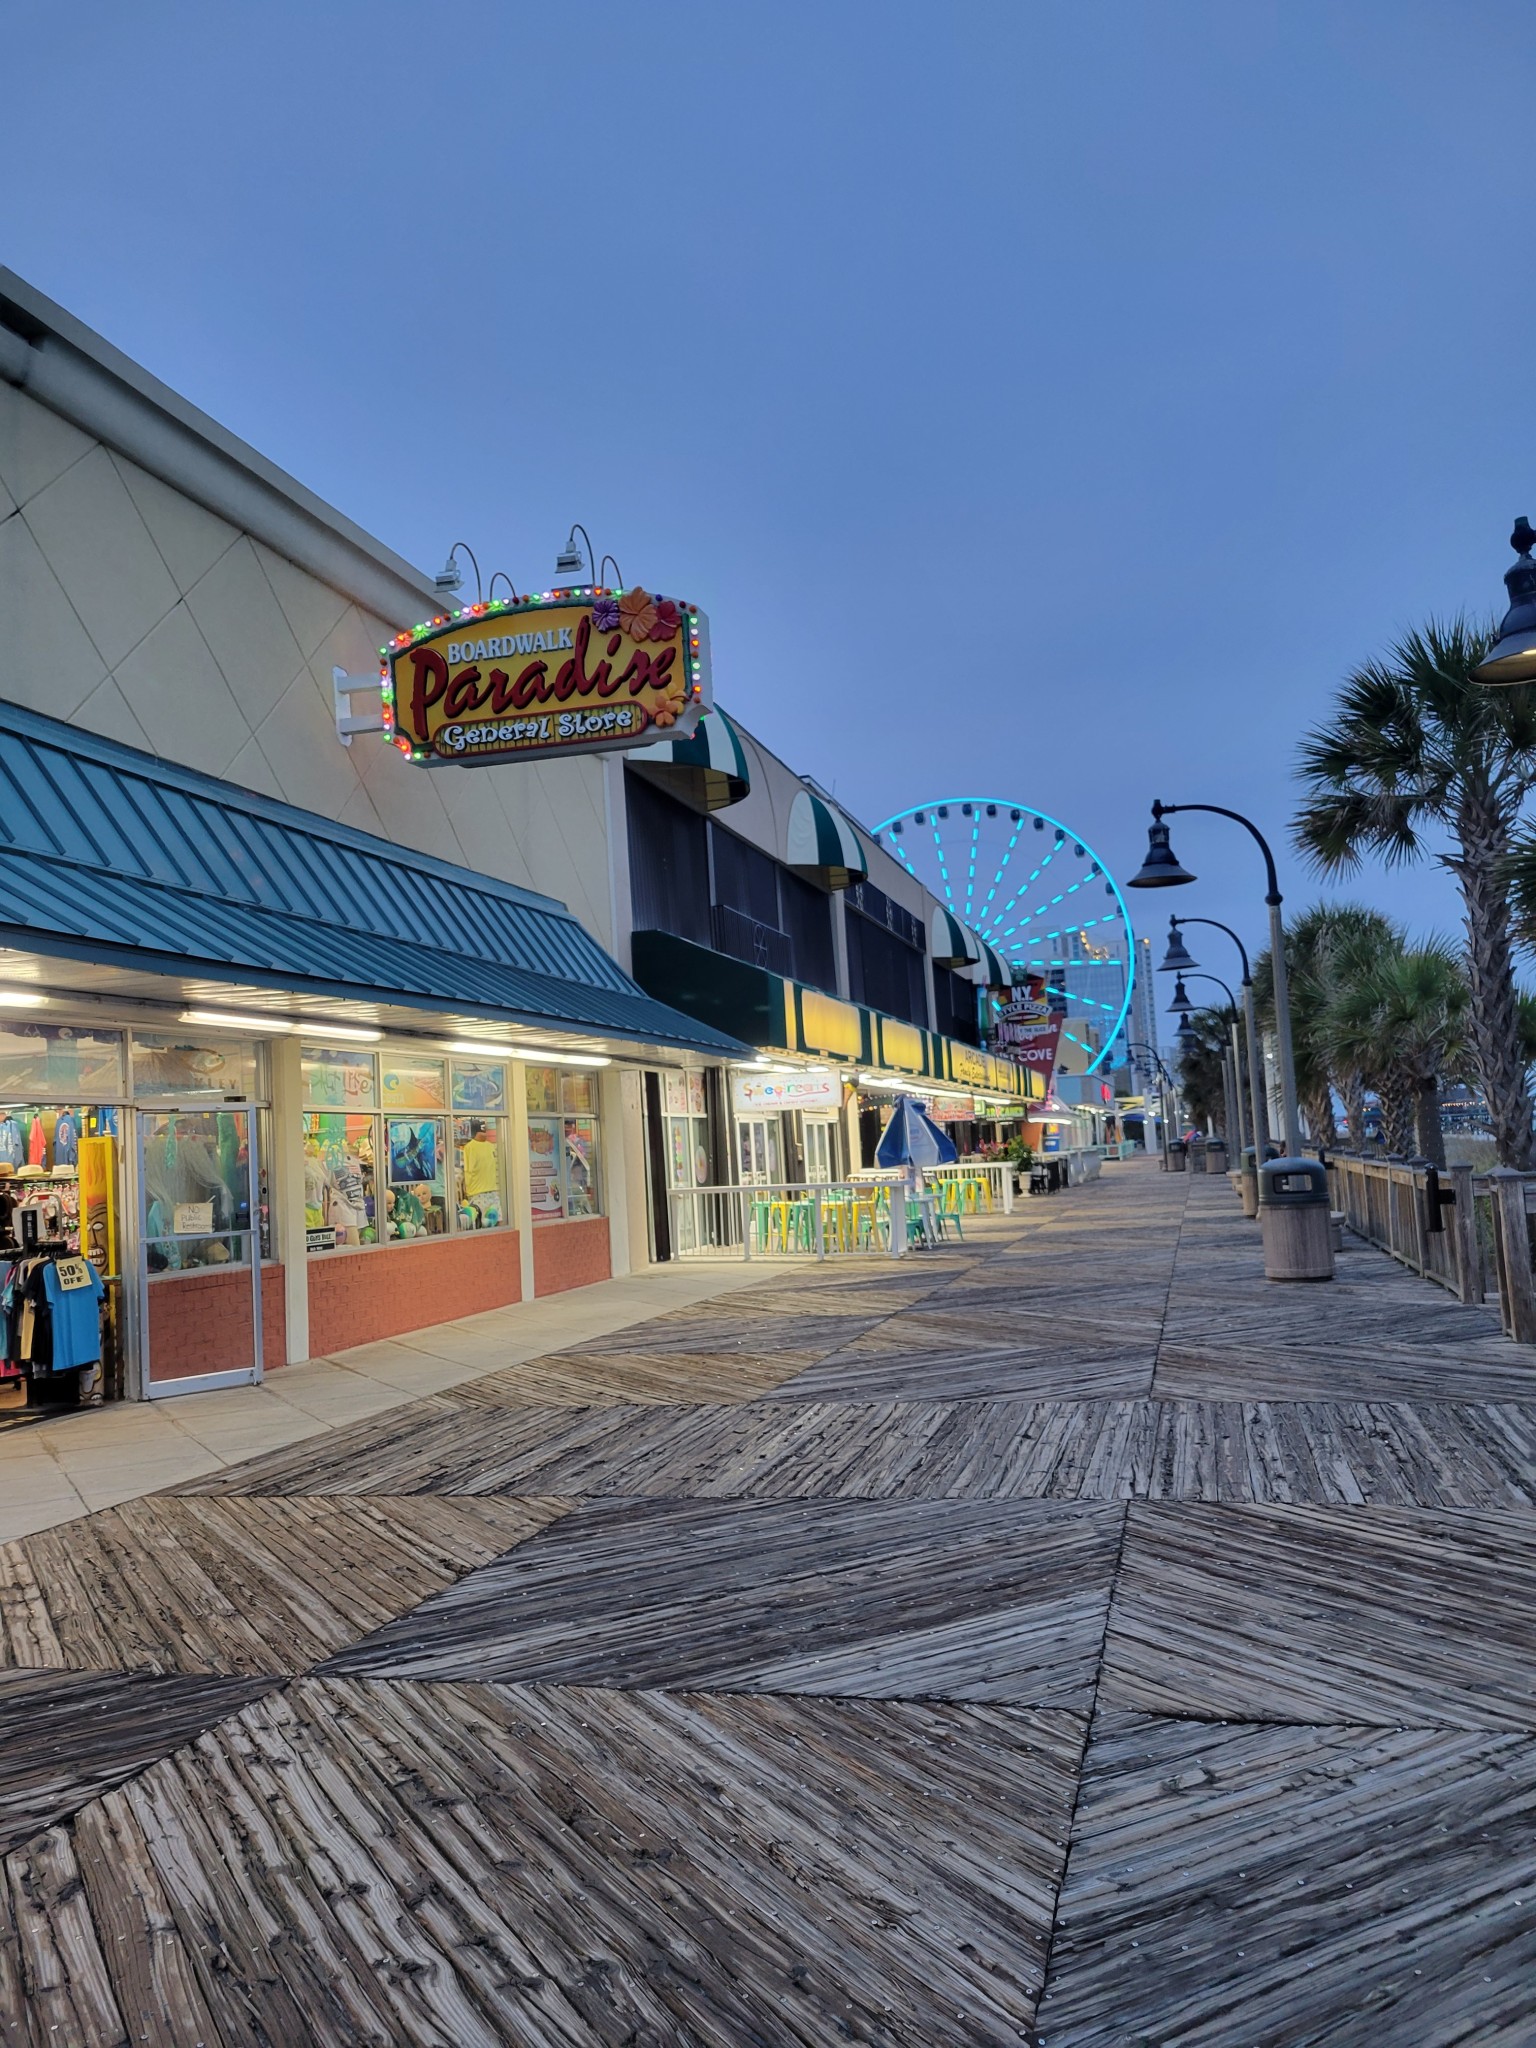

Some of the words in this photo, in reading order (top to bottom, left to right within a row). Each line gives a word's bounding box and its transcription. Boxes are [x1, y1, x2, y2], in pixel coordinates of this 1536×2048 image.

[447, 627, 574, 665] BOARDWALK
[410, 615, 677, 741] Paradise
[444, 717, 550, 751] General
[558, 709, 633, 737] Store
[1011, 985, 1033, 1002] N.Y.
[1024, 1003, 1050, 1015] PIZZA
[1018, 1048, 1053, 1061] COVE
[59, 1263, 84, 1277] 50%
[63, 1275, 84, 1285] OFF
